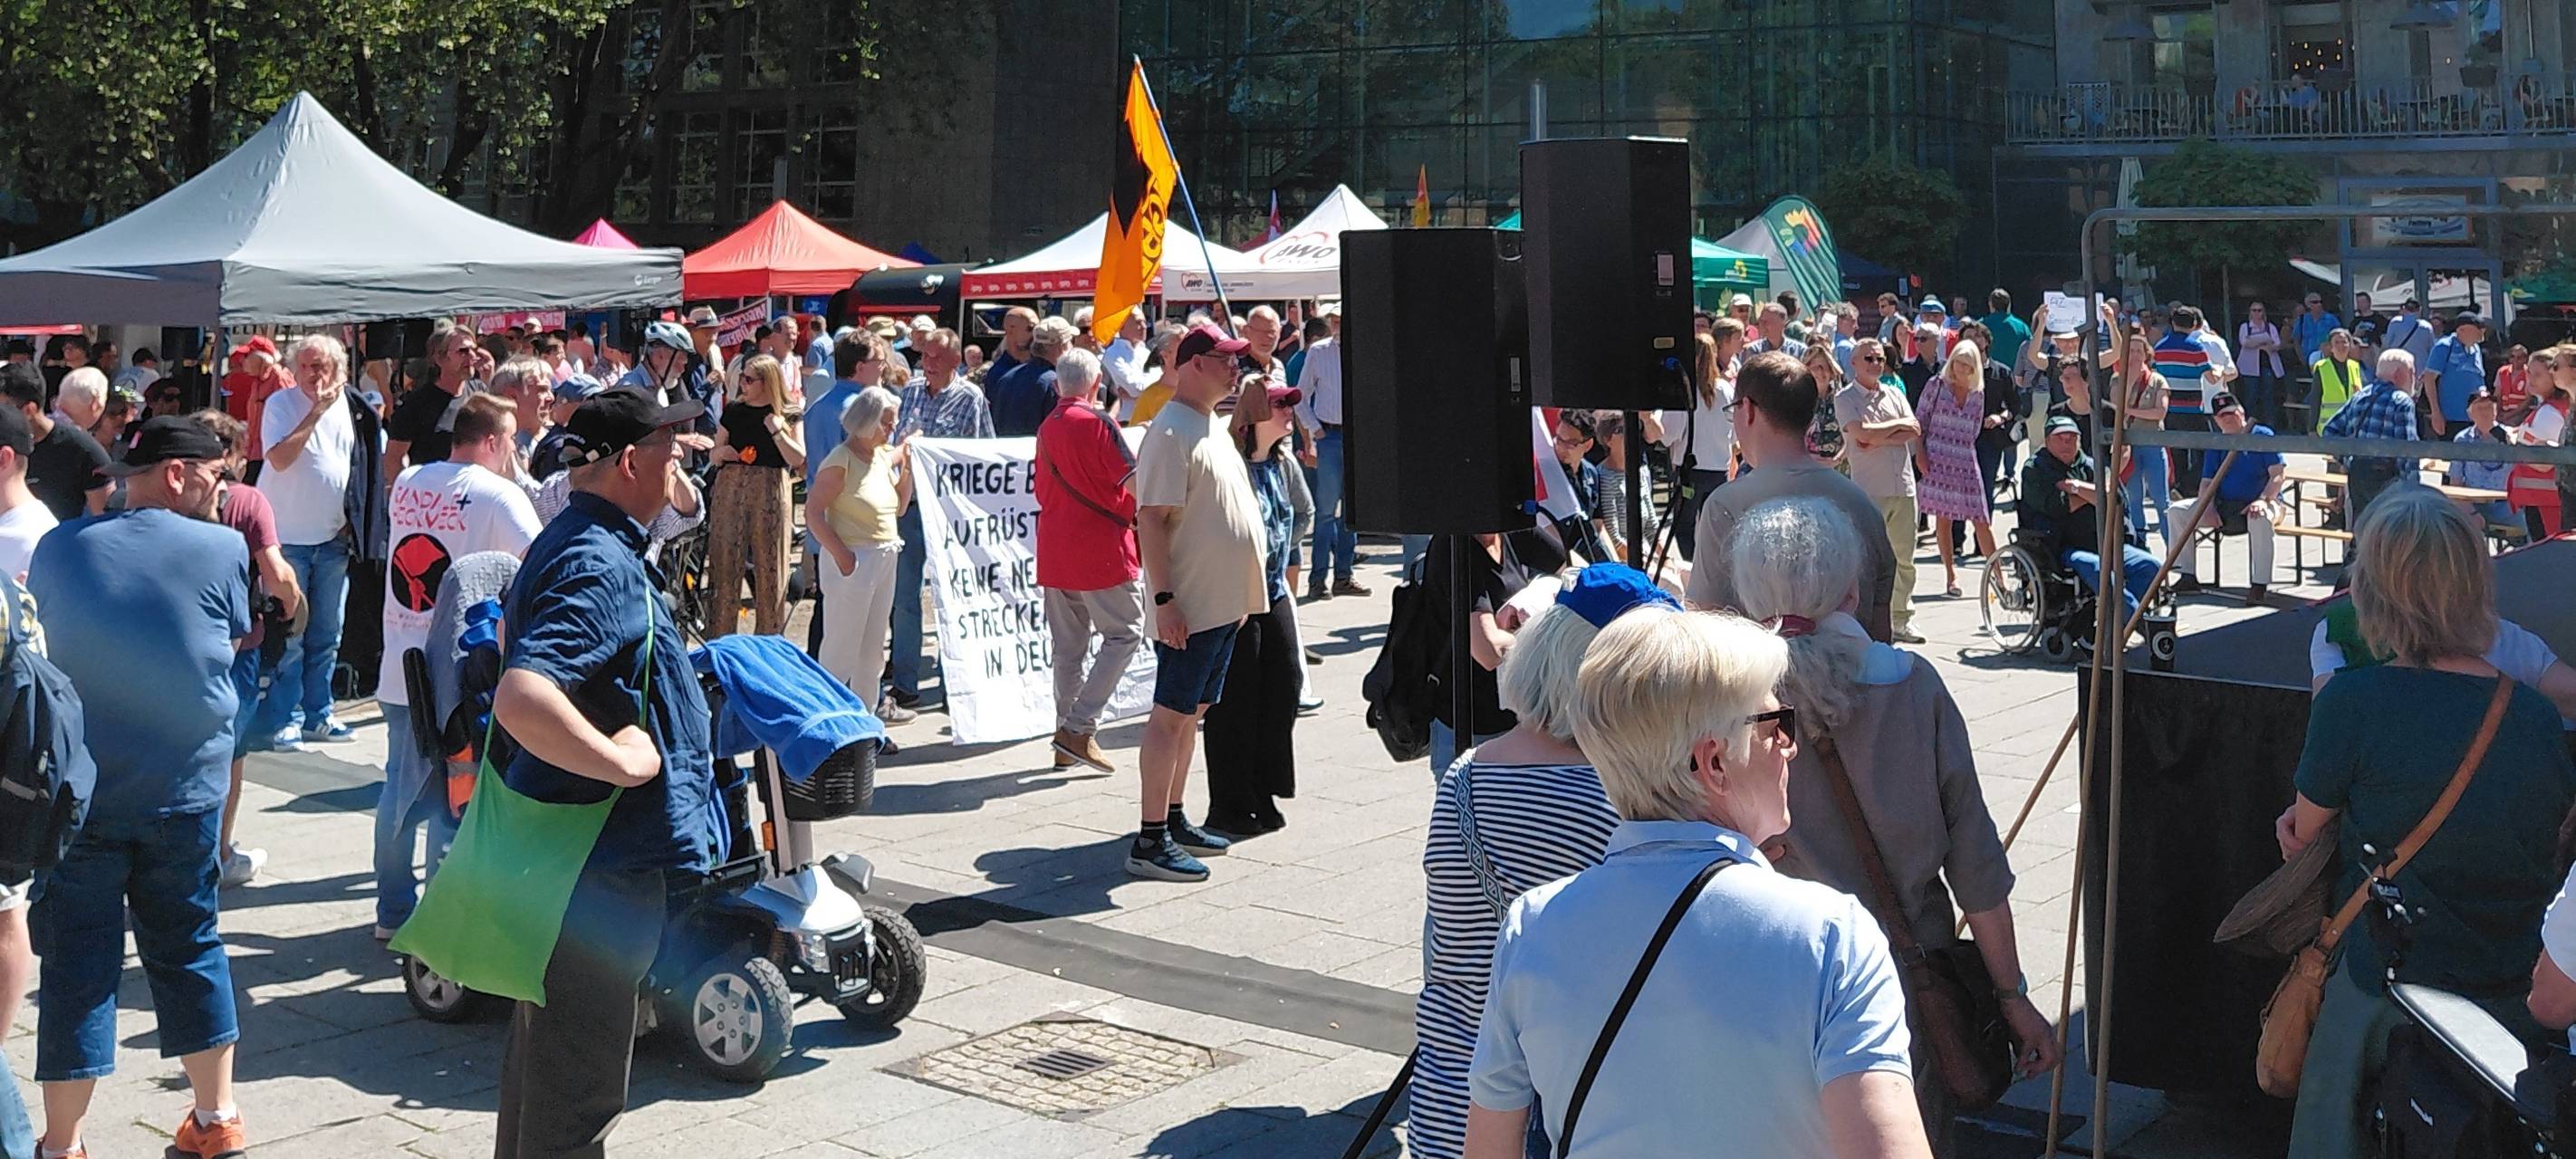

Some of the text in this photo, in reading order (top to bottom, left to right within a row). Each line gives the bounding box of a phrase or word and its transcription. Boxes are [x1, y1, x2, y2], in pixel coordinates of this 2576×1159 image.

[1269, 244, 1337, 260] AWO
[1186, 279, 1204, 288] AWO
[936, 462, 1019, 498] KRIEGE
[947, 561, 1002, 599] KEINE
[985, 648, 1002, 679] IN
